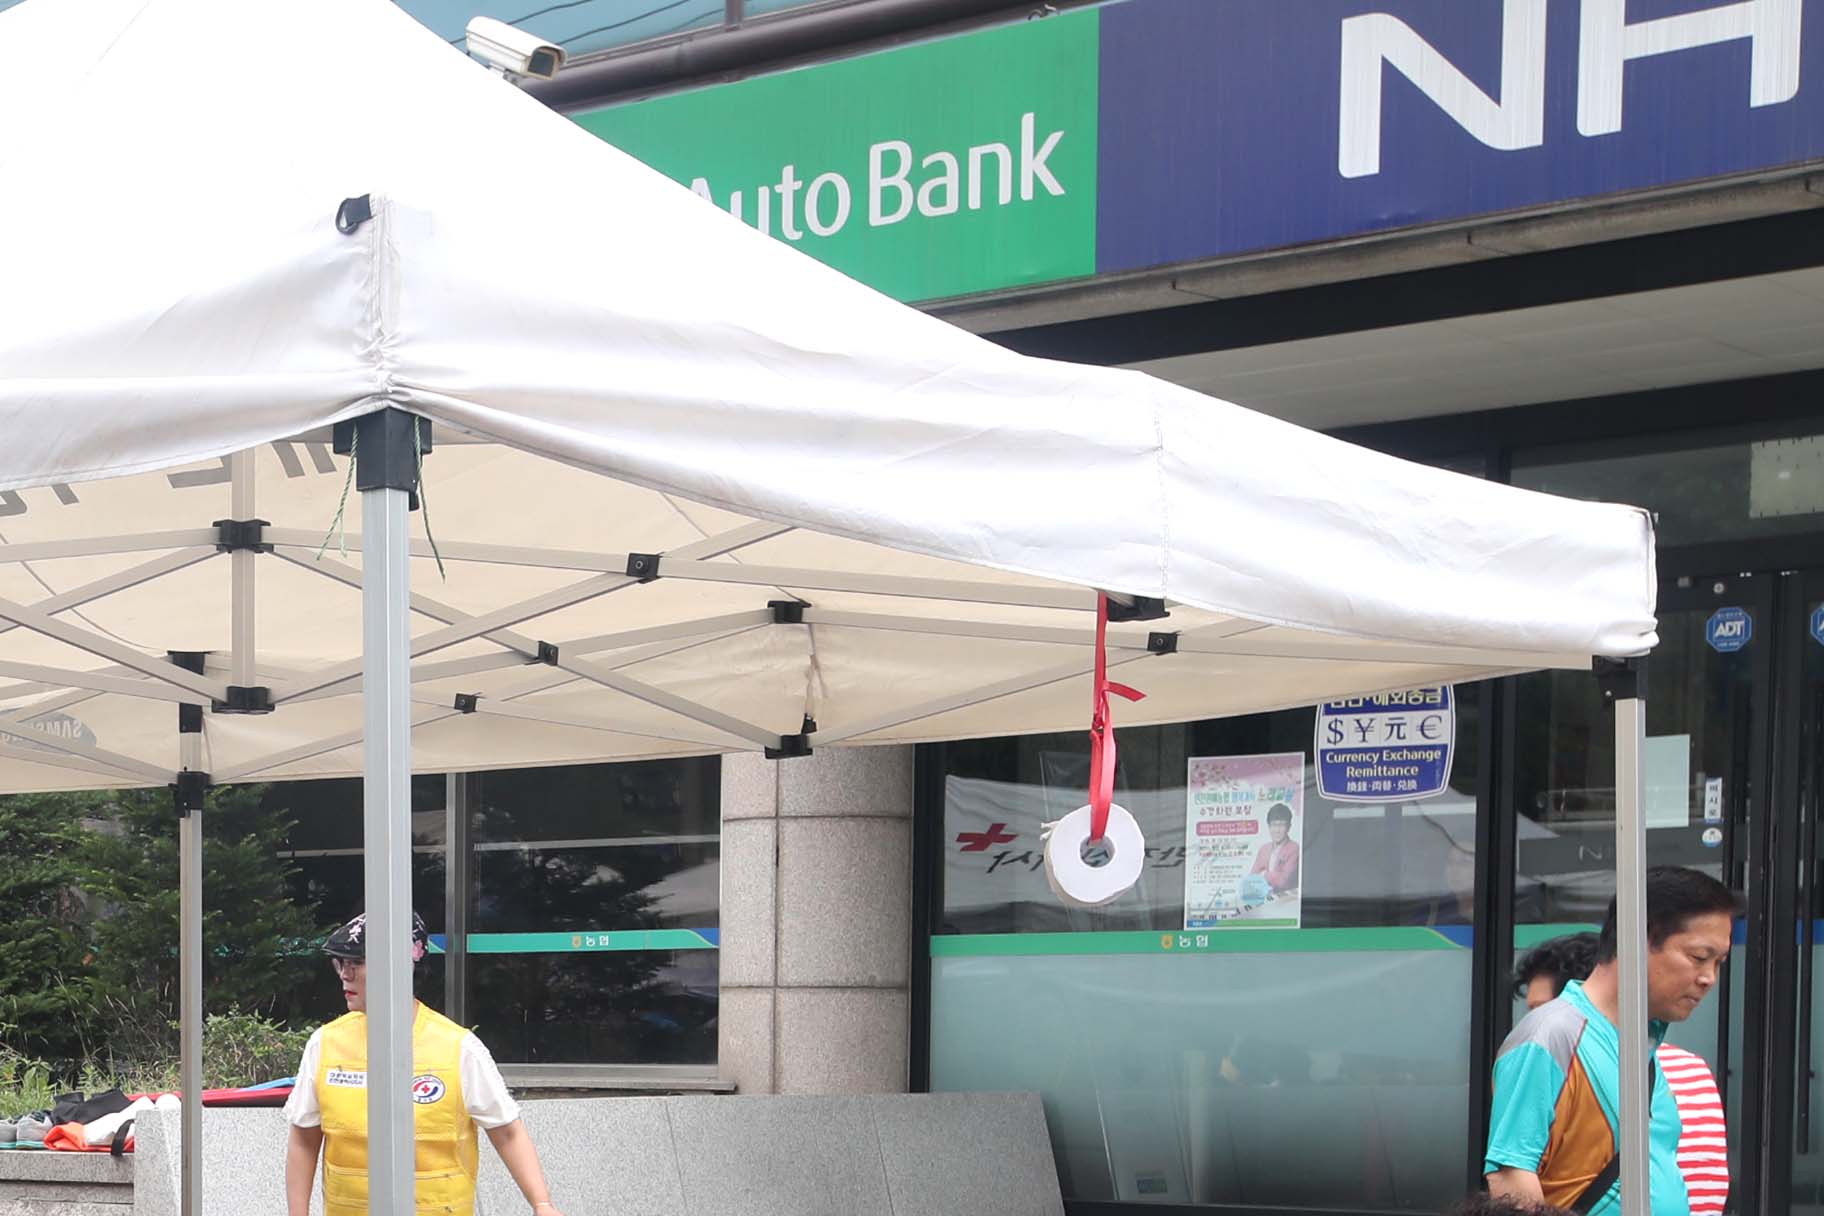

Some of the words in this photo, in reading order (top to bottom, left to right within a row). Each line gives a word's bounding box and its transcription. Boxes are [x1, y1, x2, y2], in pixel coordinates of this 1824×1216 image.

[868, 111, 1066, 227] Bank
[1714, 620, 1745, 638] ADT
[1326, 751, 1379, 764] Currency
[1382, 748, 1442, 762] Exchange
[1346, 764, 1419, 778] Remittance
[1179, 935, 1208, 948] 농협
